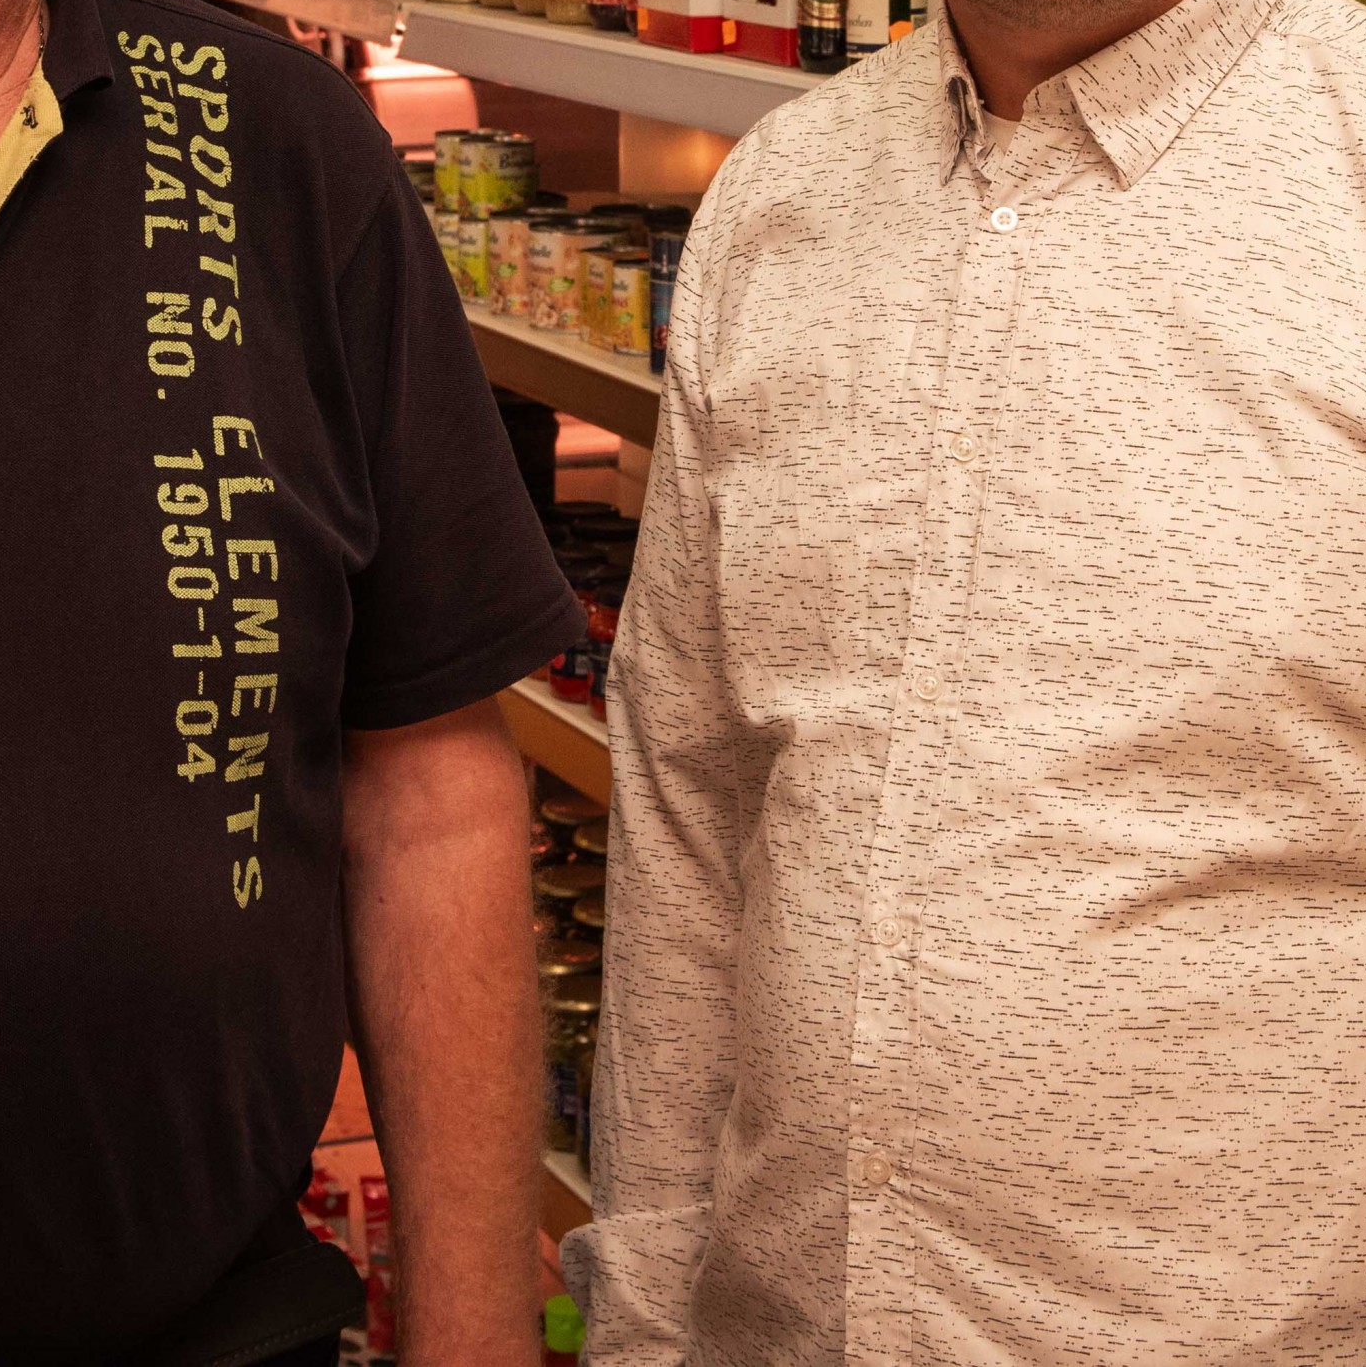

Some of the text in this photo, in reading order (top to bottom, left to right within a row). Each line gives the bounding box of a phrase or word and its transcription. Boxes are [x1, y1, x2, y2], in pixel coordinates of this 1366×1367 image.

[117, 30, 223, 783] SERIAL NO. 1950-1-04
[170, 41, 280, 910] SPORTS ELEMENTS
